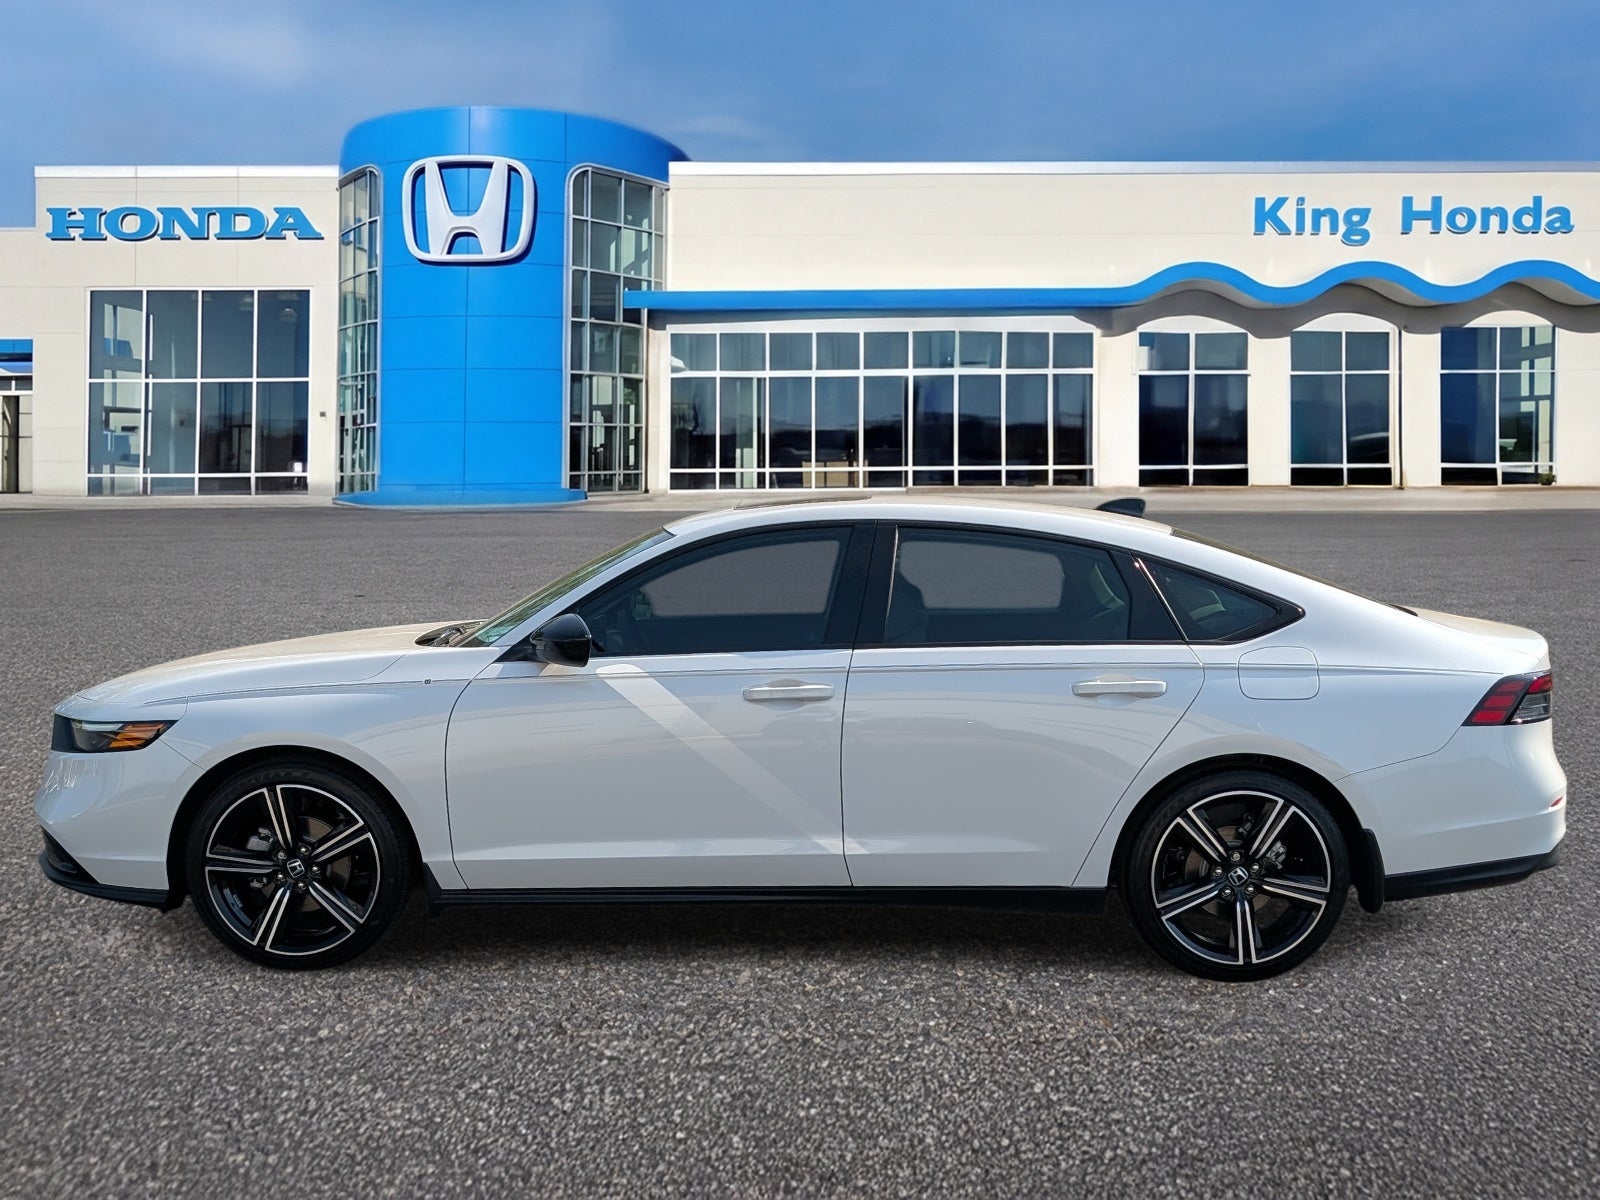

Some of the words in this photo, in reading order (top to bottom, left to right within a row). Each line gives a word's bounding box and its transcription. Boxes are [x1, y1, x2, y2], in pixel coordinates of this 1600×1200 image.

[46, 206, 325, 241] HONDA
[1253, 196, 1372, 246] King
[1401, 195, 1575, 235] Honda
